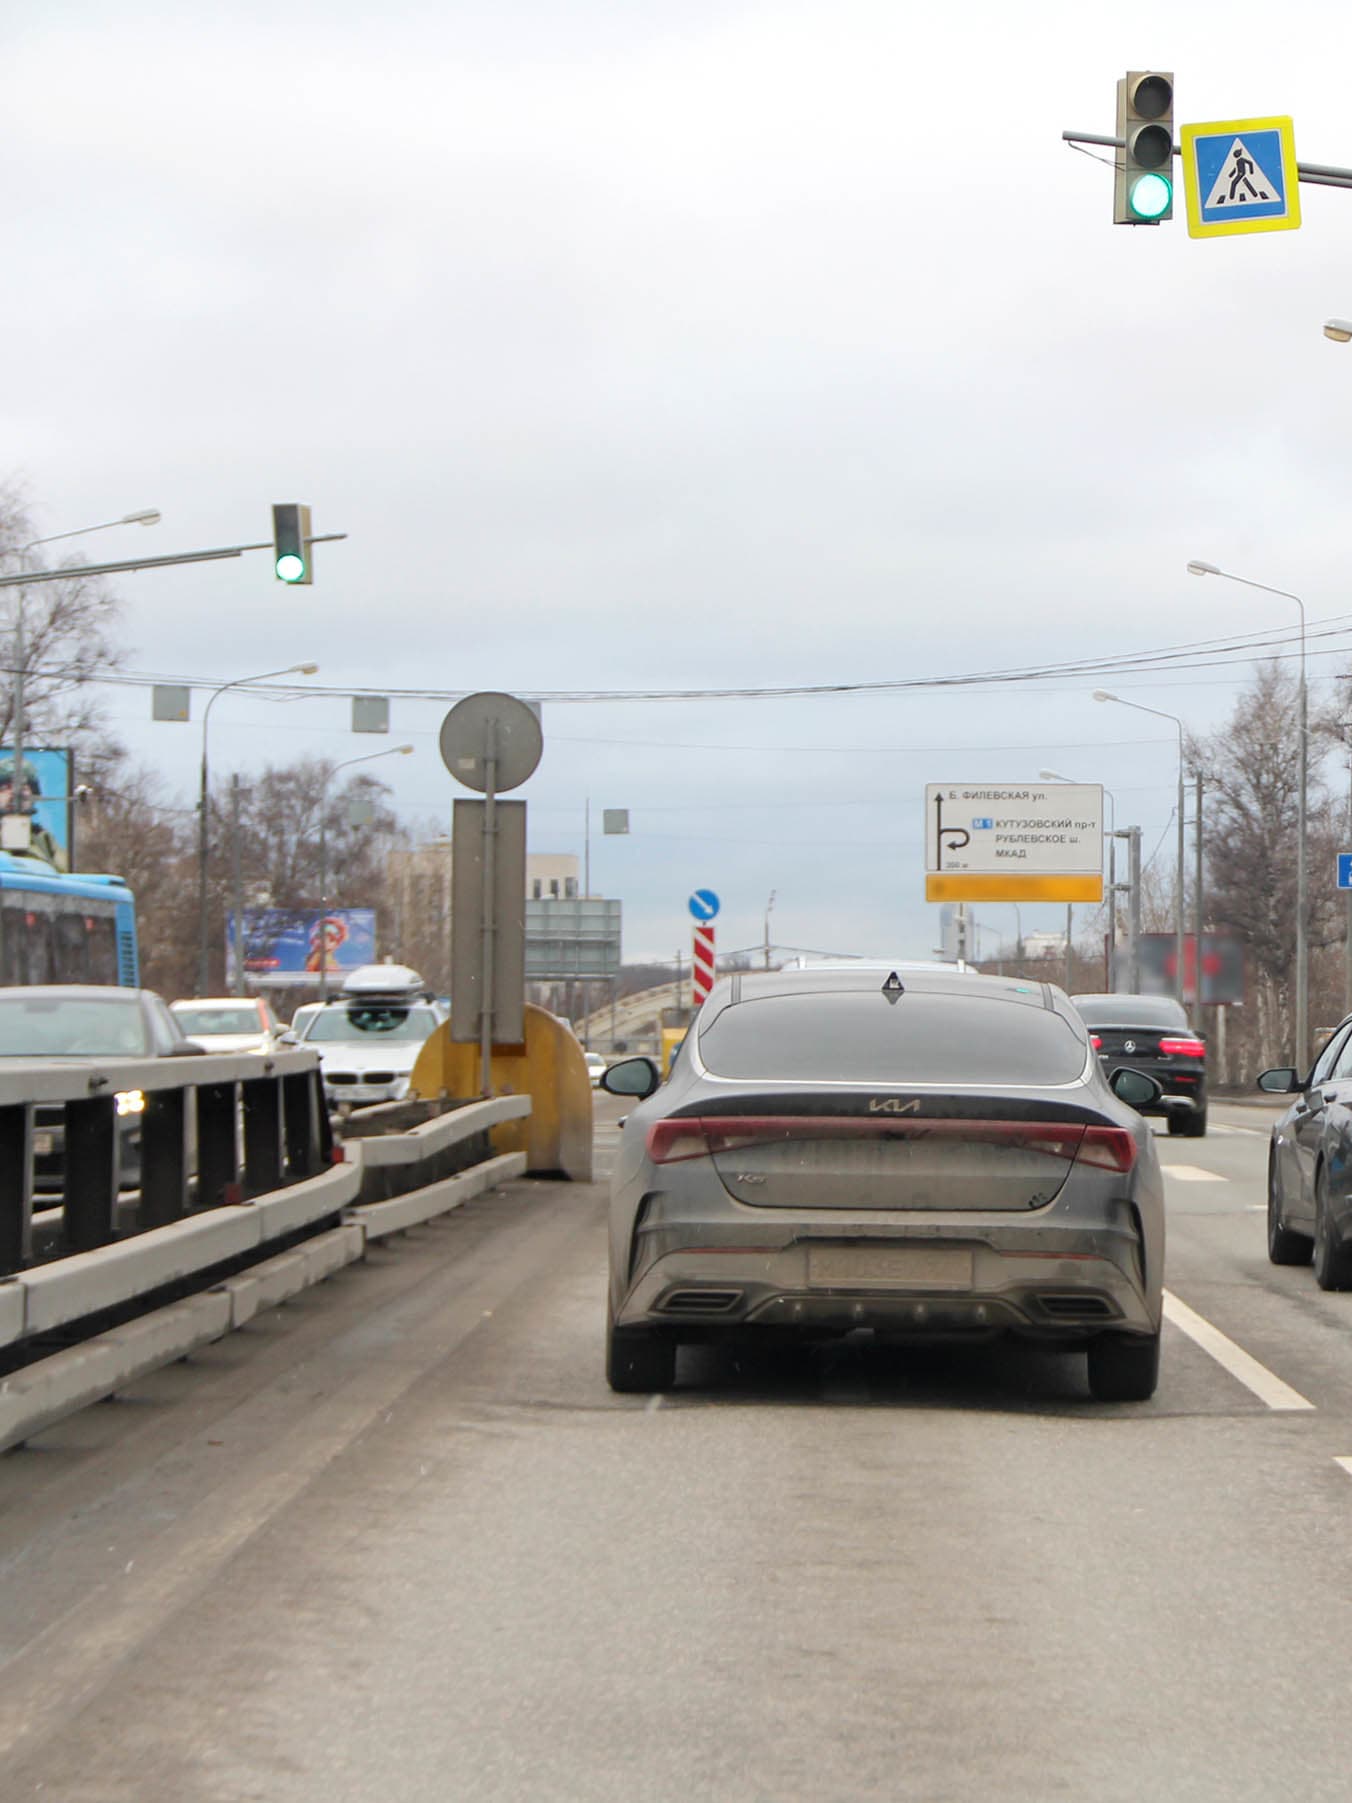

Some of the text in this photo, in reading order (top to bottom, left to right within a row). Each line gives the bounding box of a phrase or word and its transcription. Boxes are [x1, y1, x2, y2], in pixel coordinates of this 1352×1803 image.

[962, 791, 1029, 800] ФИЛЕВСКАЯ
[995, 818, 1073, 829] КУТУЗОВСКИЙ
[1074, 821, 1096, 830] пр-т
[995, 834, 1066, 844] РУБЛЕВСКОЕ
[995, 849, 1027, 858] МКАД
